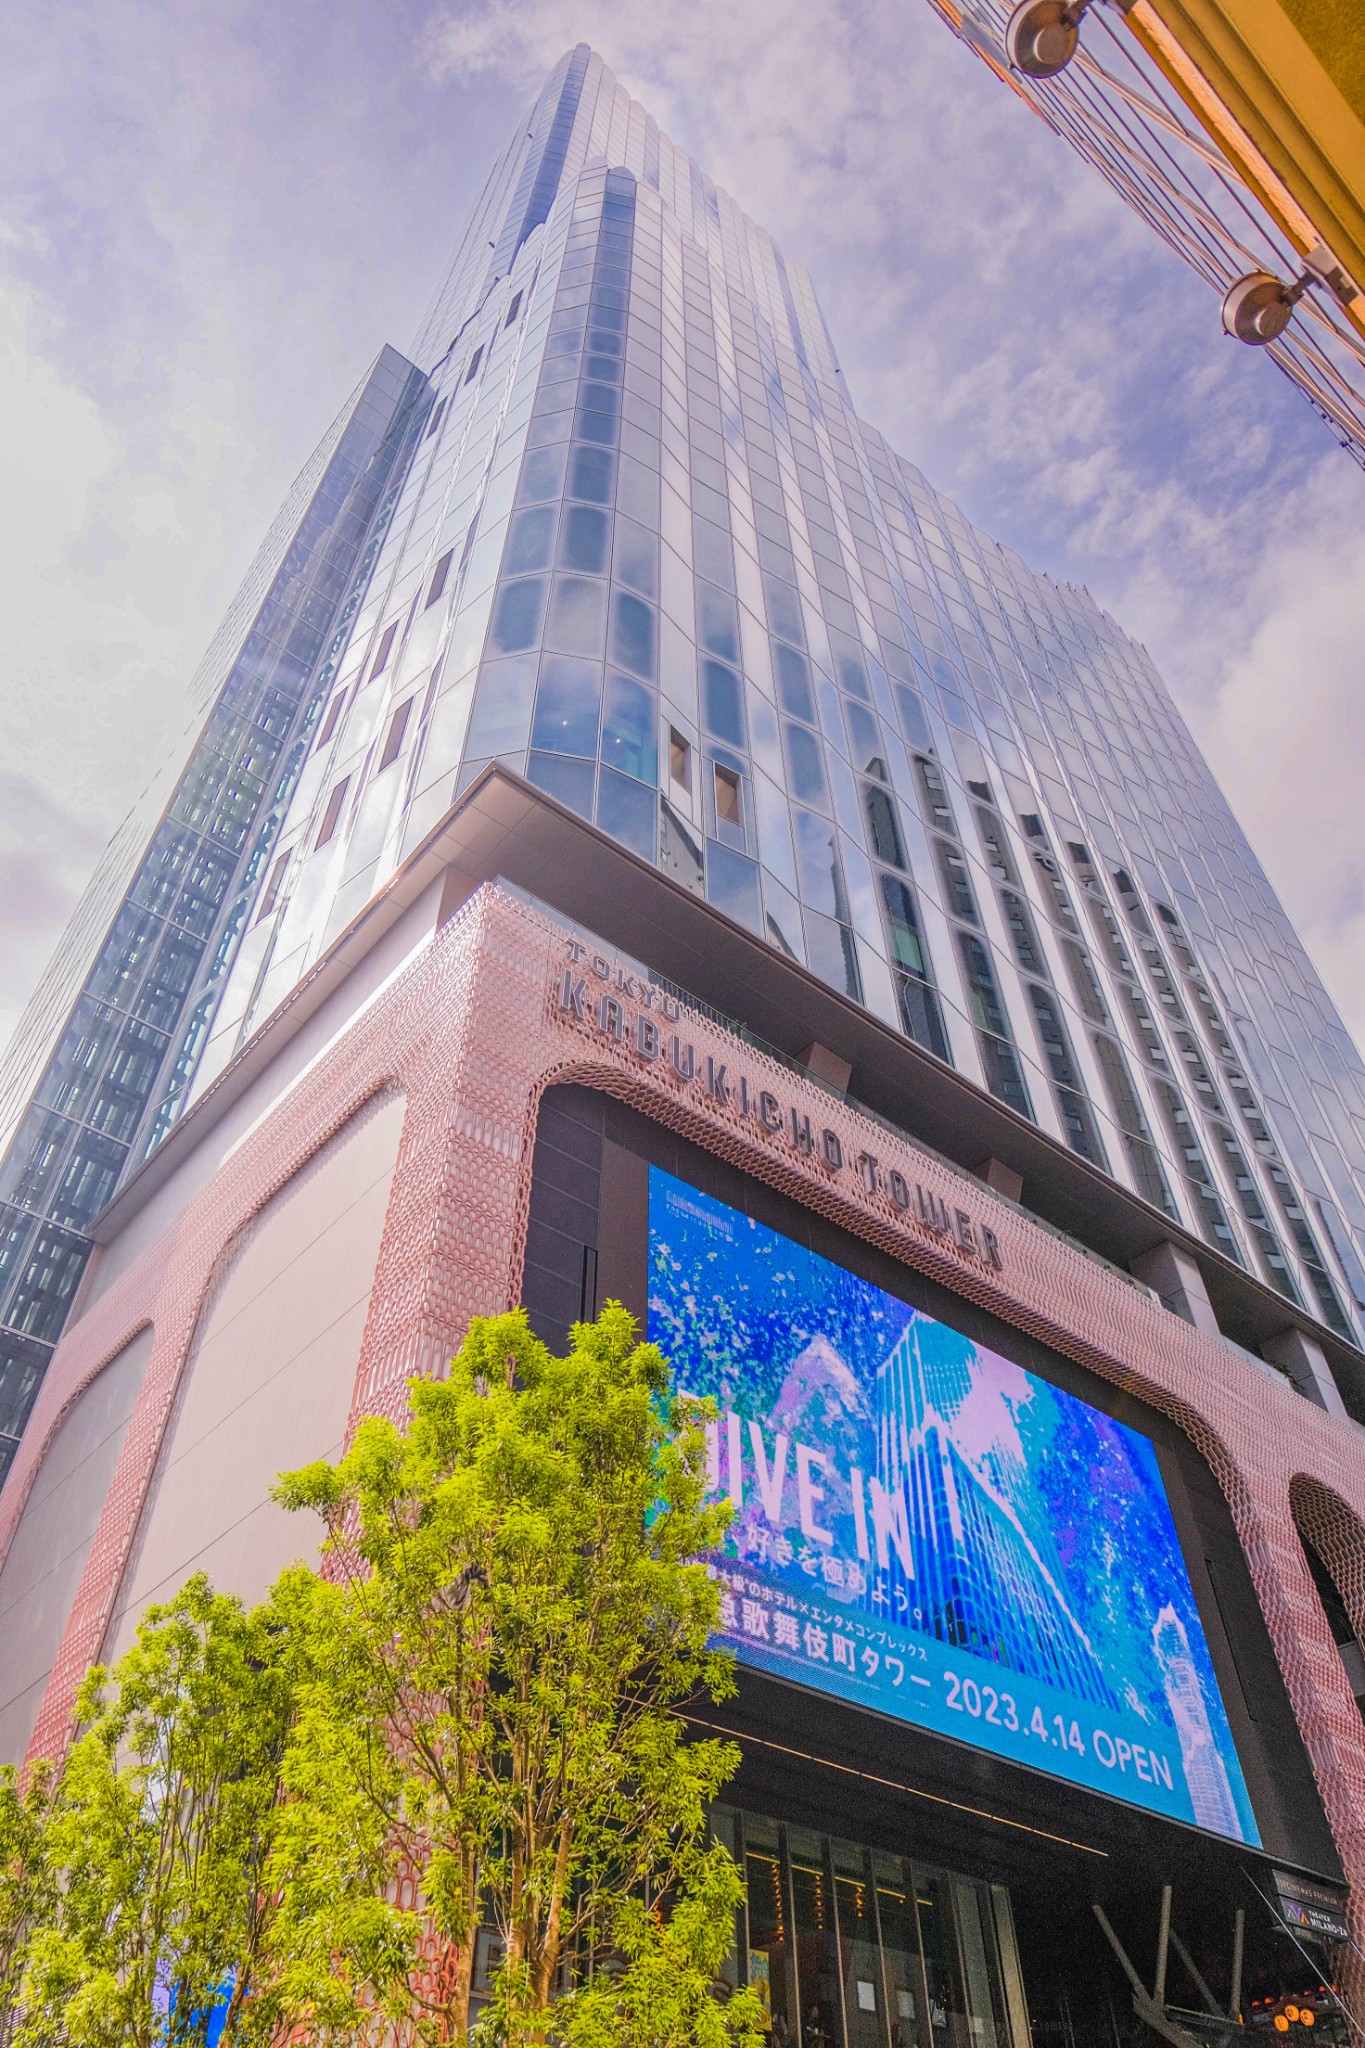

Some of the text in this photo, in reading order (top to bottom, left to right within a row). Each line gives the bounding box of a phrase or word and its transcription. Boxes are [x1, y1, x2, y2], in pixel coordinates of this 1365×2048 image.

[566, 937, 680, 1022] TOKYU
[561, 968, 1002, 1270] KABUKICHO TOWER
[850, 1466, 915, 1581] IN
[943, 1671, 1085, 1757] 2023.4.14
[1093, 1729, 1174, 1791] OPEN
